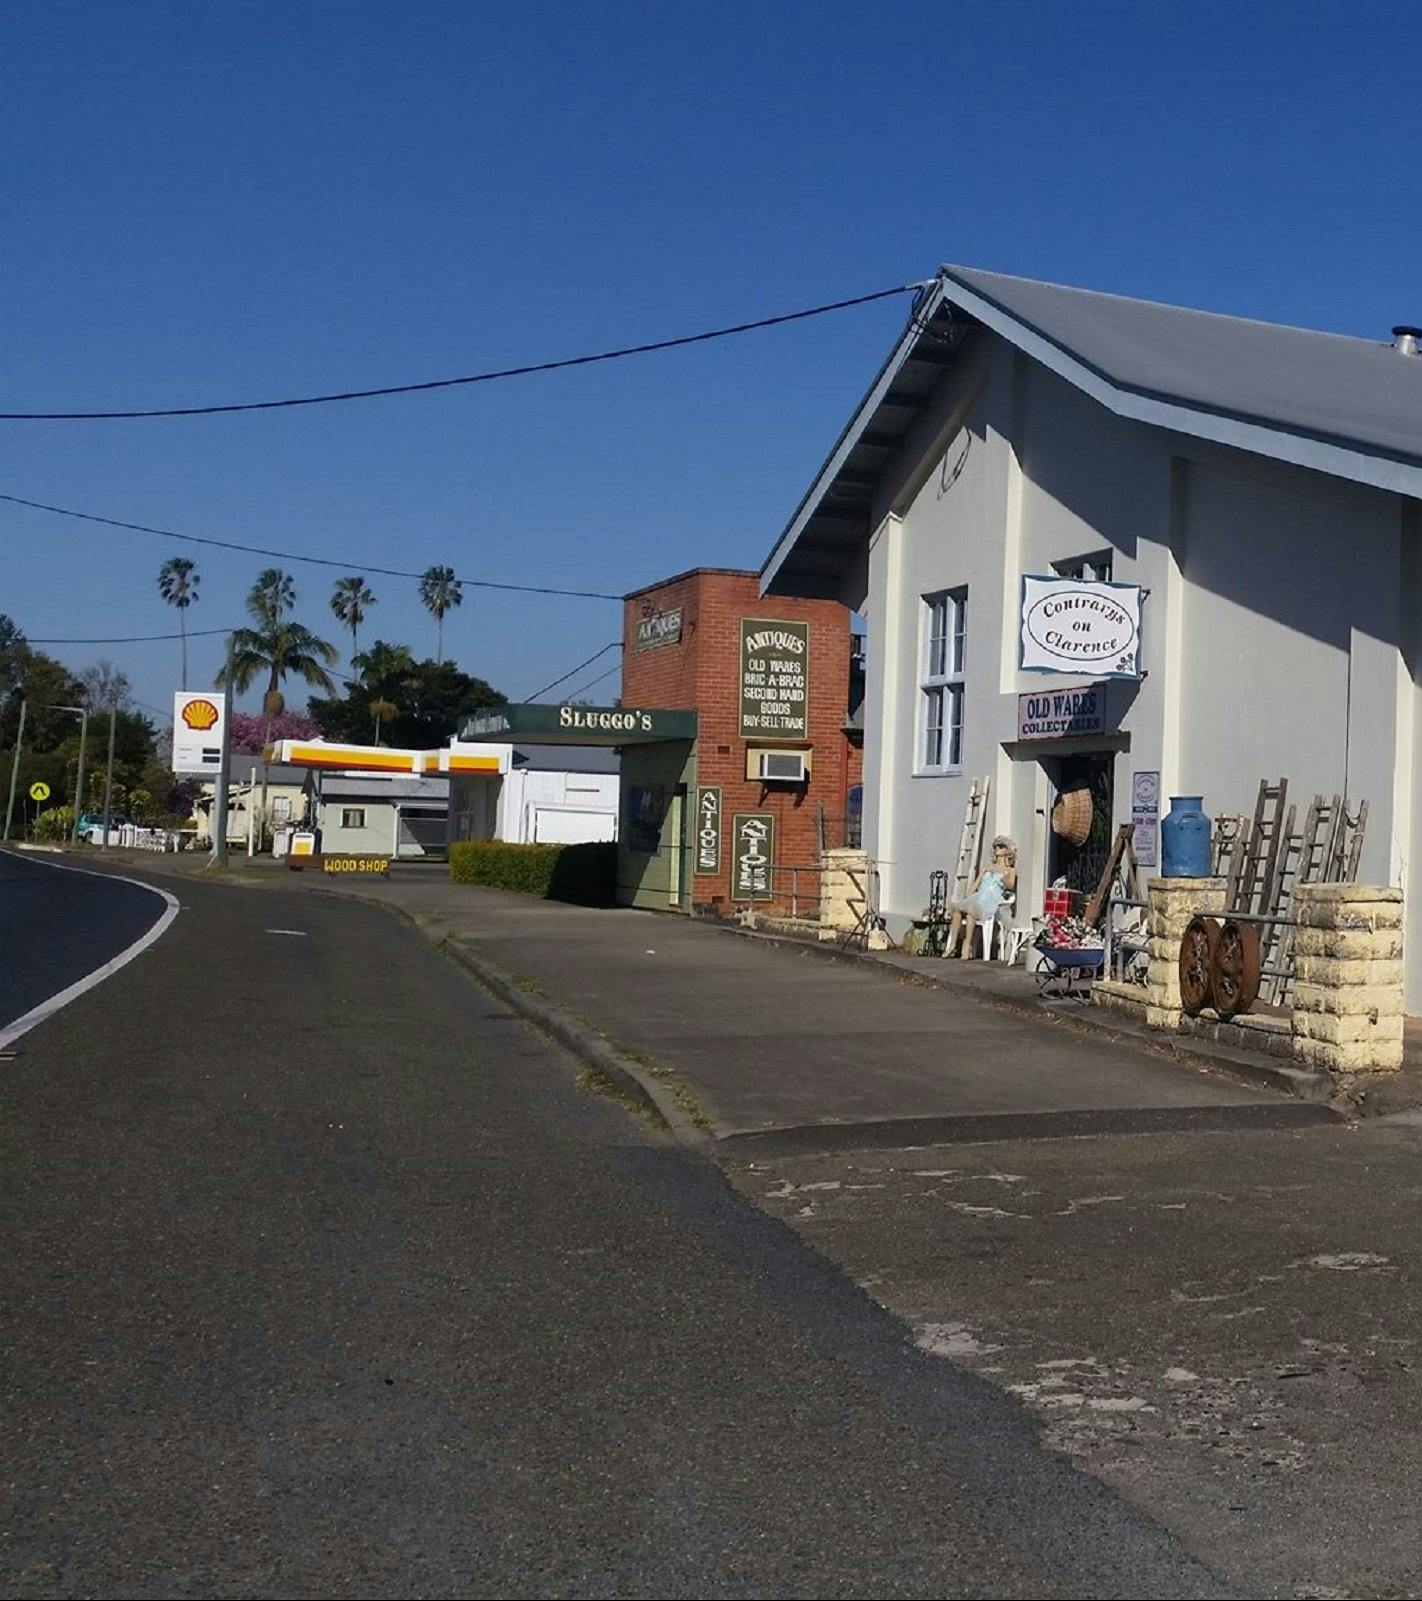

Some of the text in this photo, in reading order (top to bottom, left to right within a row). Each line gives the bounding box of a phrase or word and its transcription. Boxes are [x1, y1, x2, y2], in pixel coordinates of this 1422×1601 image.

[1043, 596, 1126, 625] Contrarys
[1072, 620, 1092, 632] on
[745, 631, 806, 654] ANTIQUES
[1045, 631, 1117, 654] Clarence
[748, 658, 801, 674] OLD WARES
[743, 687, 805, 701] SECOND HAND
[760, 701, 791, 715] GOODS
[1027, 692, 1097, 720] OLD WARES
[1022, 717, 1100, 735] COLLECTABLES
[700, 791, 717, 868] ANTIQUES
[739, 819, 768, 890] ANTIQUES
[324, 859, 388, 872] WOOD SHOP
